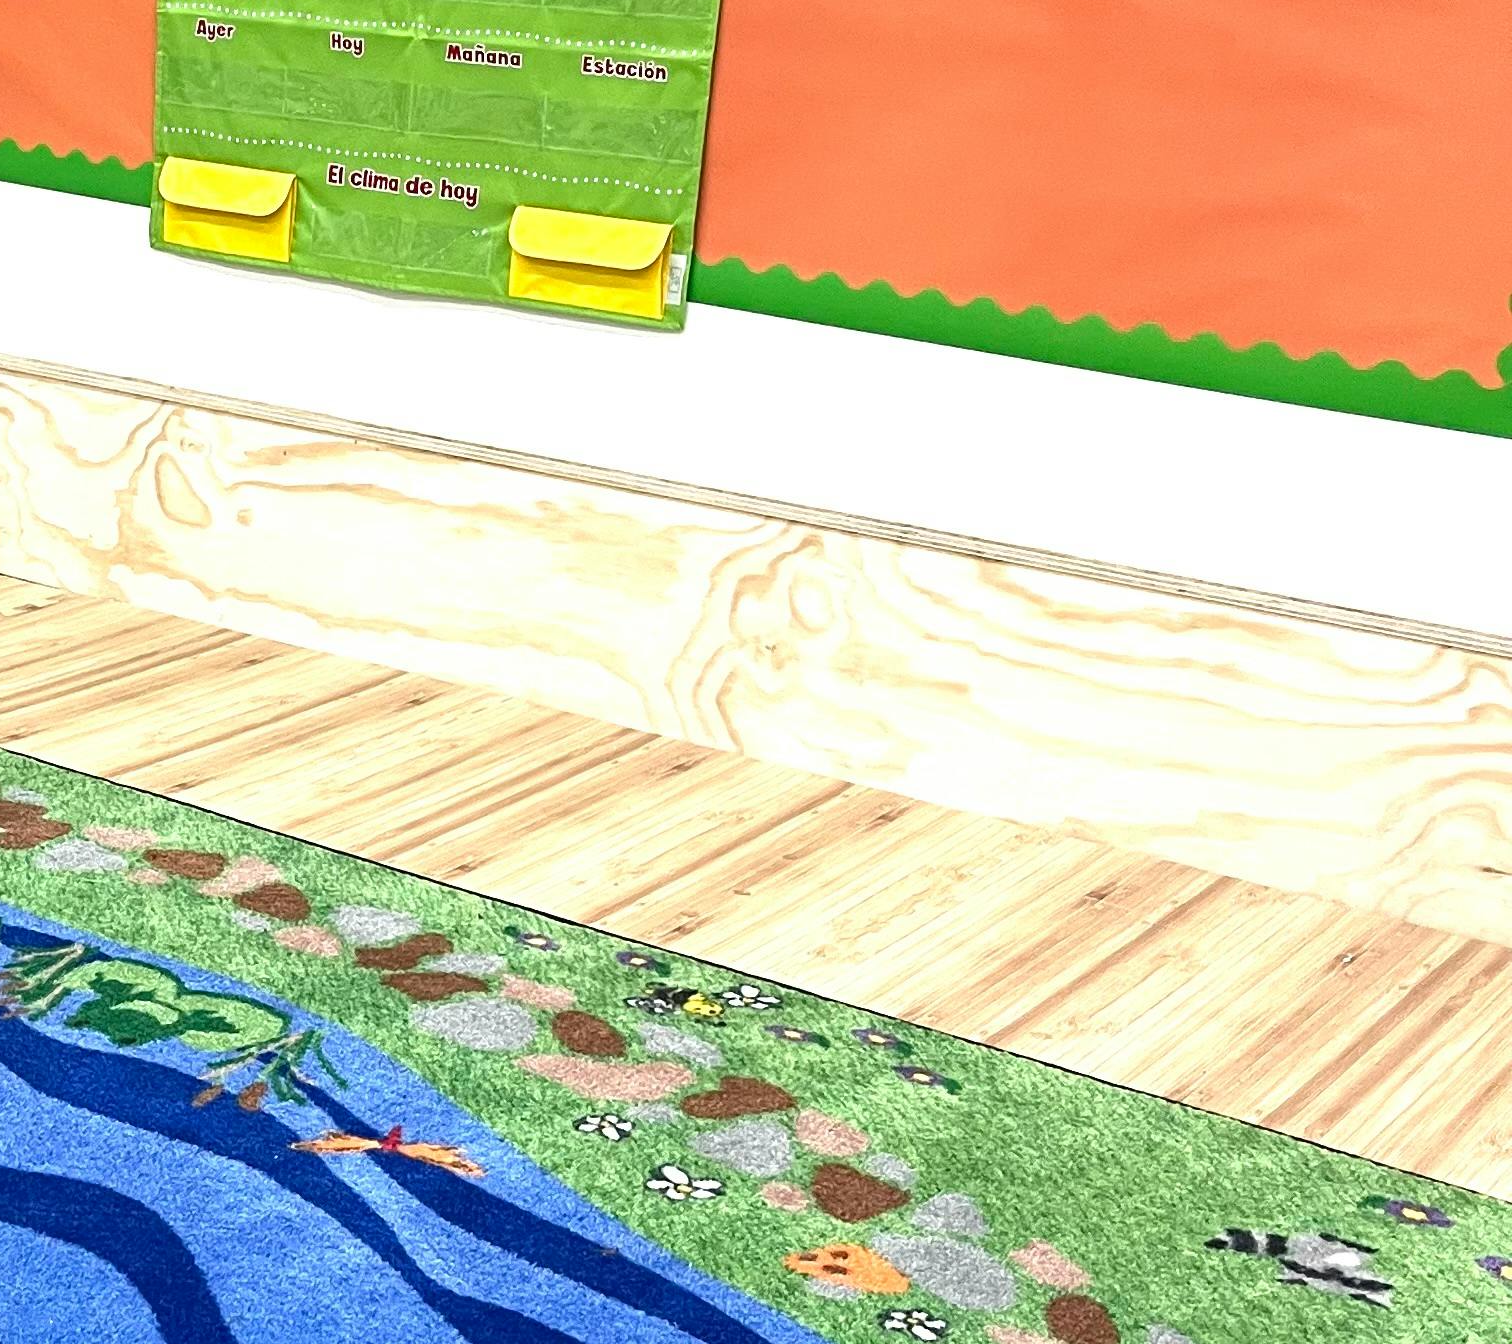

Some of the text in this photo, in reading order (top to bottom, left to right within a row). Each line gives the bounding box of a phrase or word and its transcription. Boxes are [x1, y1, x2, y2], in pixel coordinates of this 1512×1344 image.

[196, 19, 667, 81] Ayer Hoy Mañana Estación
[328, 164, 478, 207] El clima de hoy
